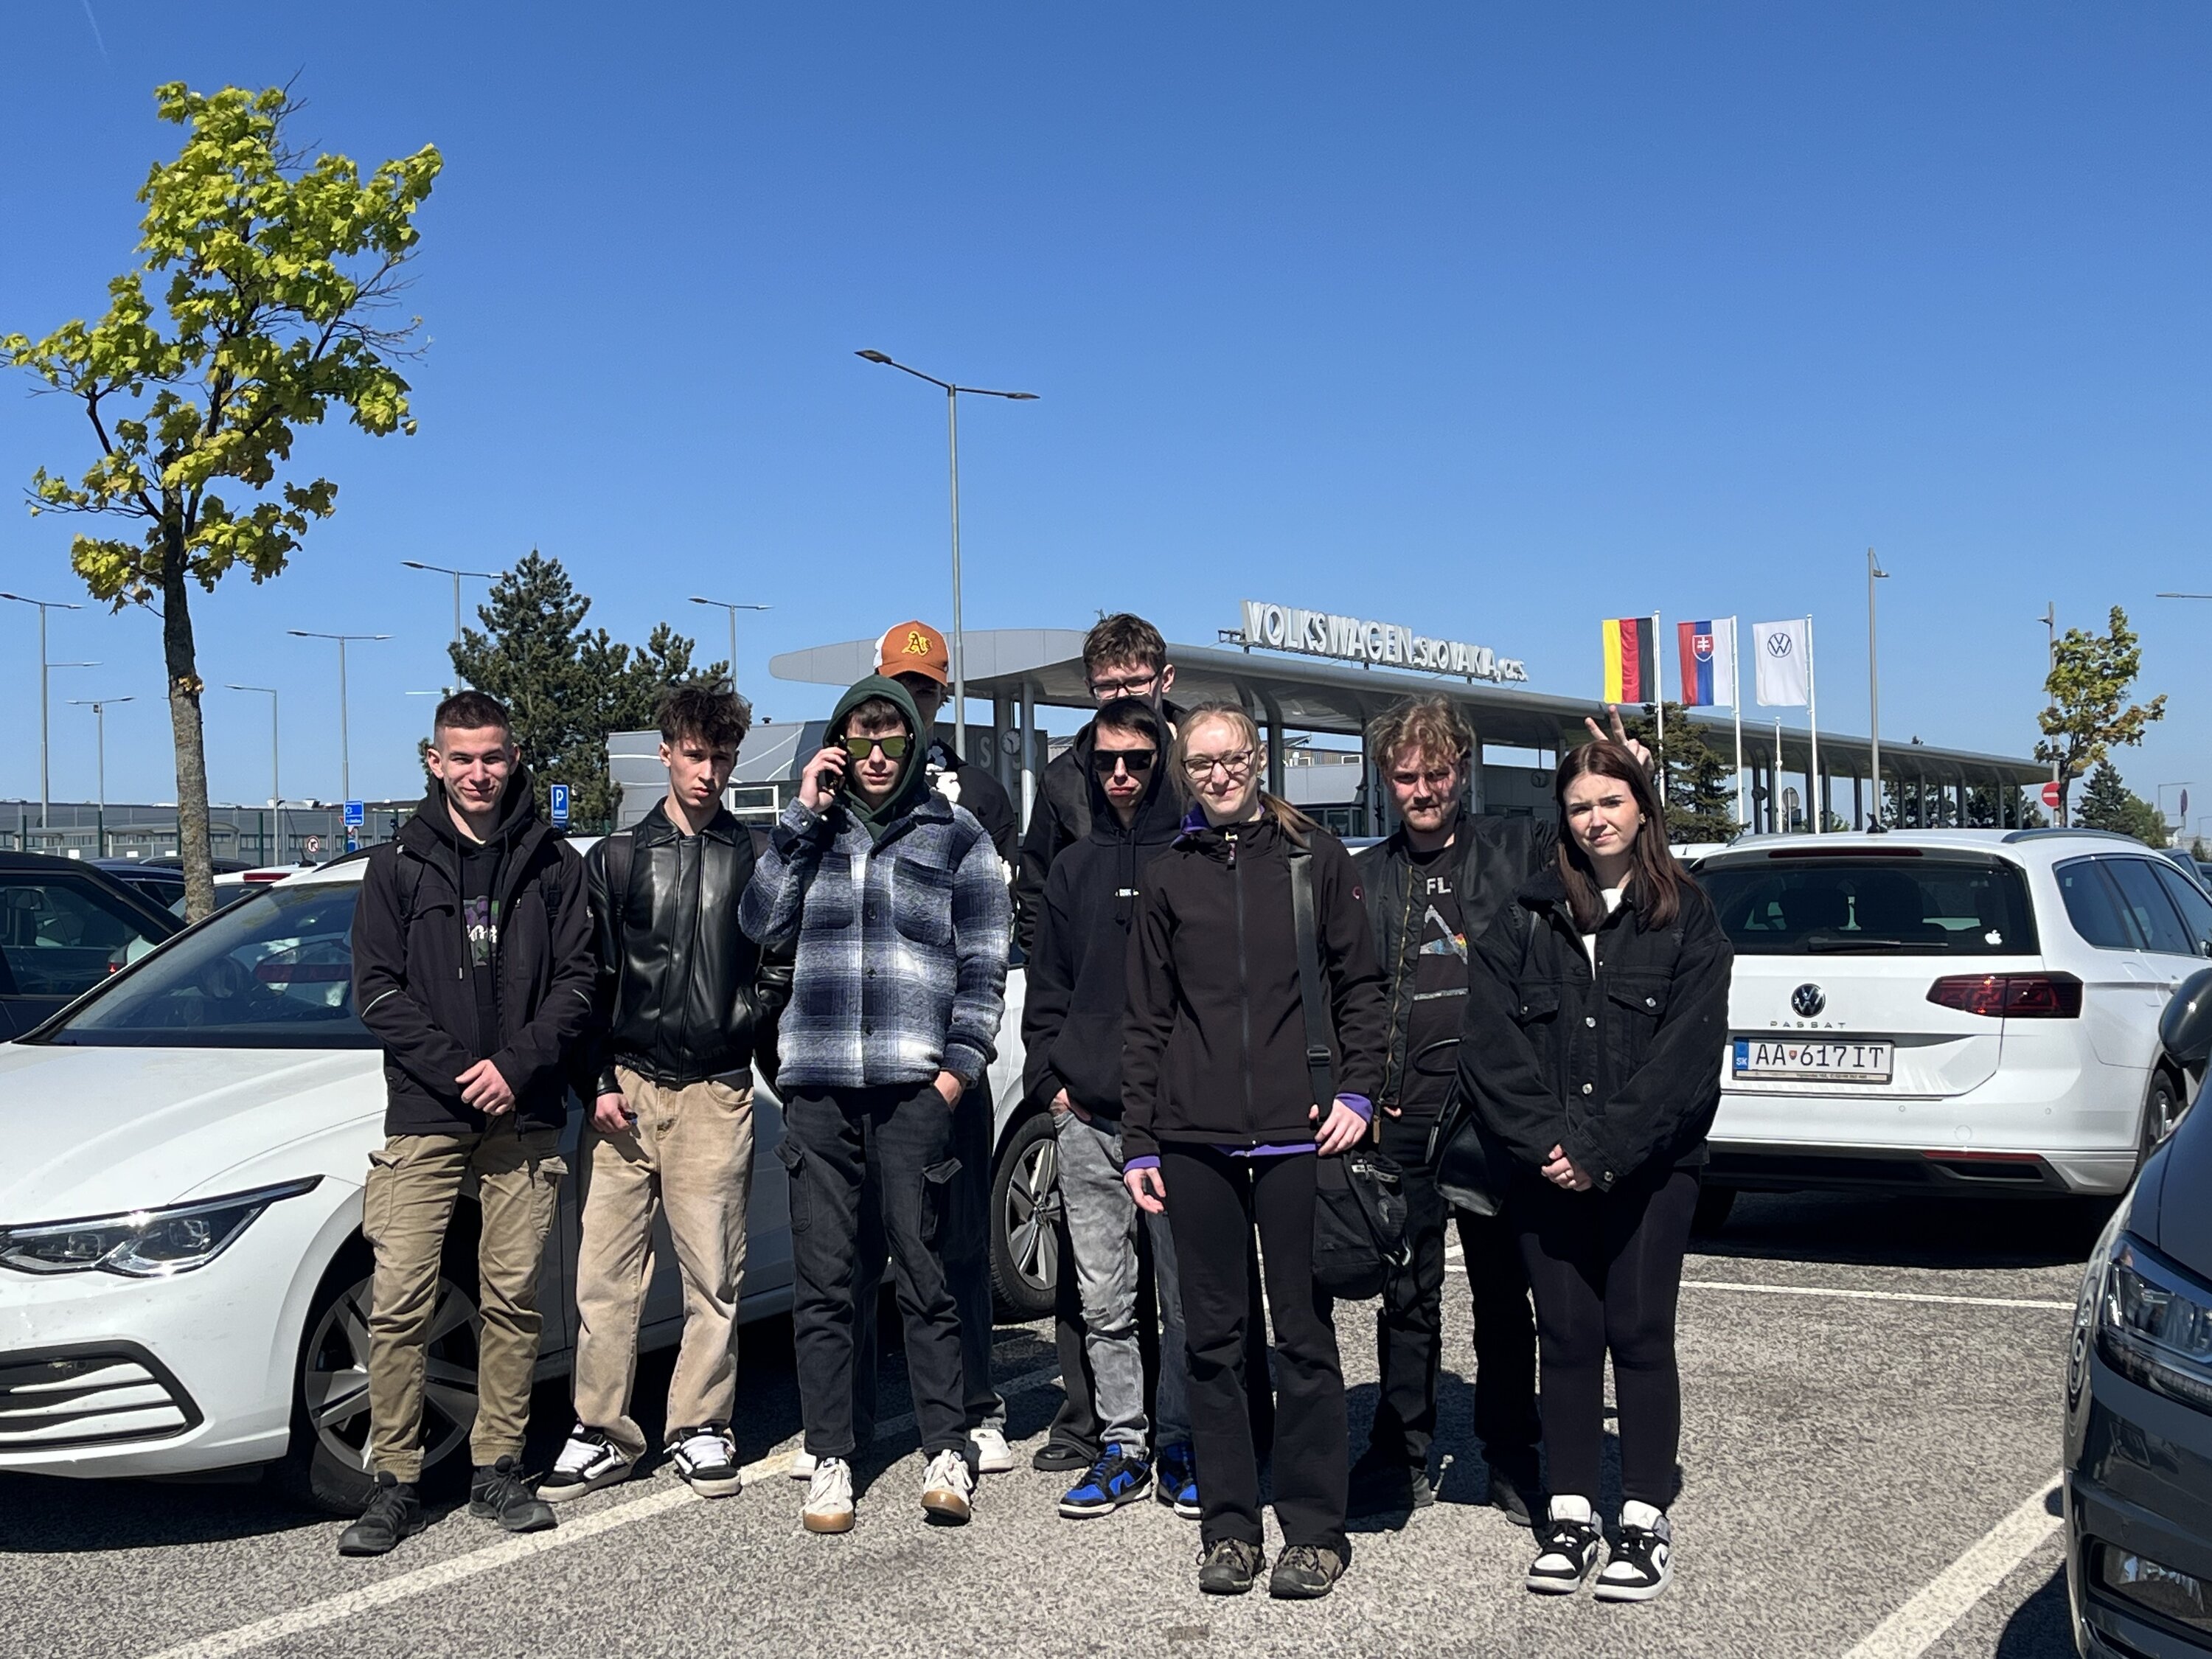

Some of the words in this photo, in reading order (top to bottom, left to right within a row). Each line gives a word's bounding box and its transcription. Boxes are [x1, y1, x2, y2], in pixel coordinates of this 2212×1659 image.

[1241, 599, 1414, 664] VOLKSWAGEN
[556, 789, 564, 807] P
[1426, 877, 1453, 895] FL
[1770, 1020, 1846, 1029] PASSAT
[1736, 1057, 1747, 1066] SK
